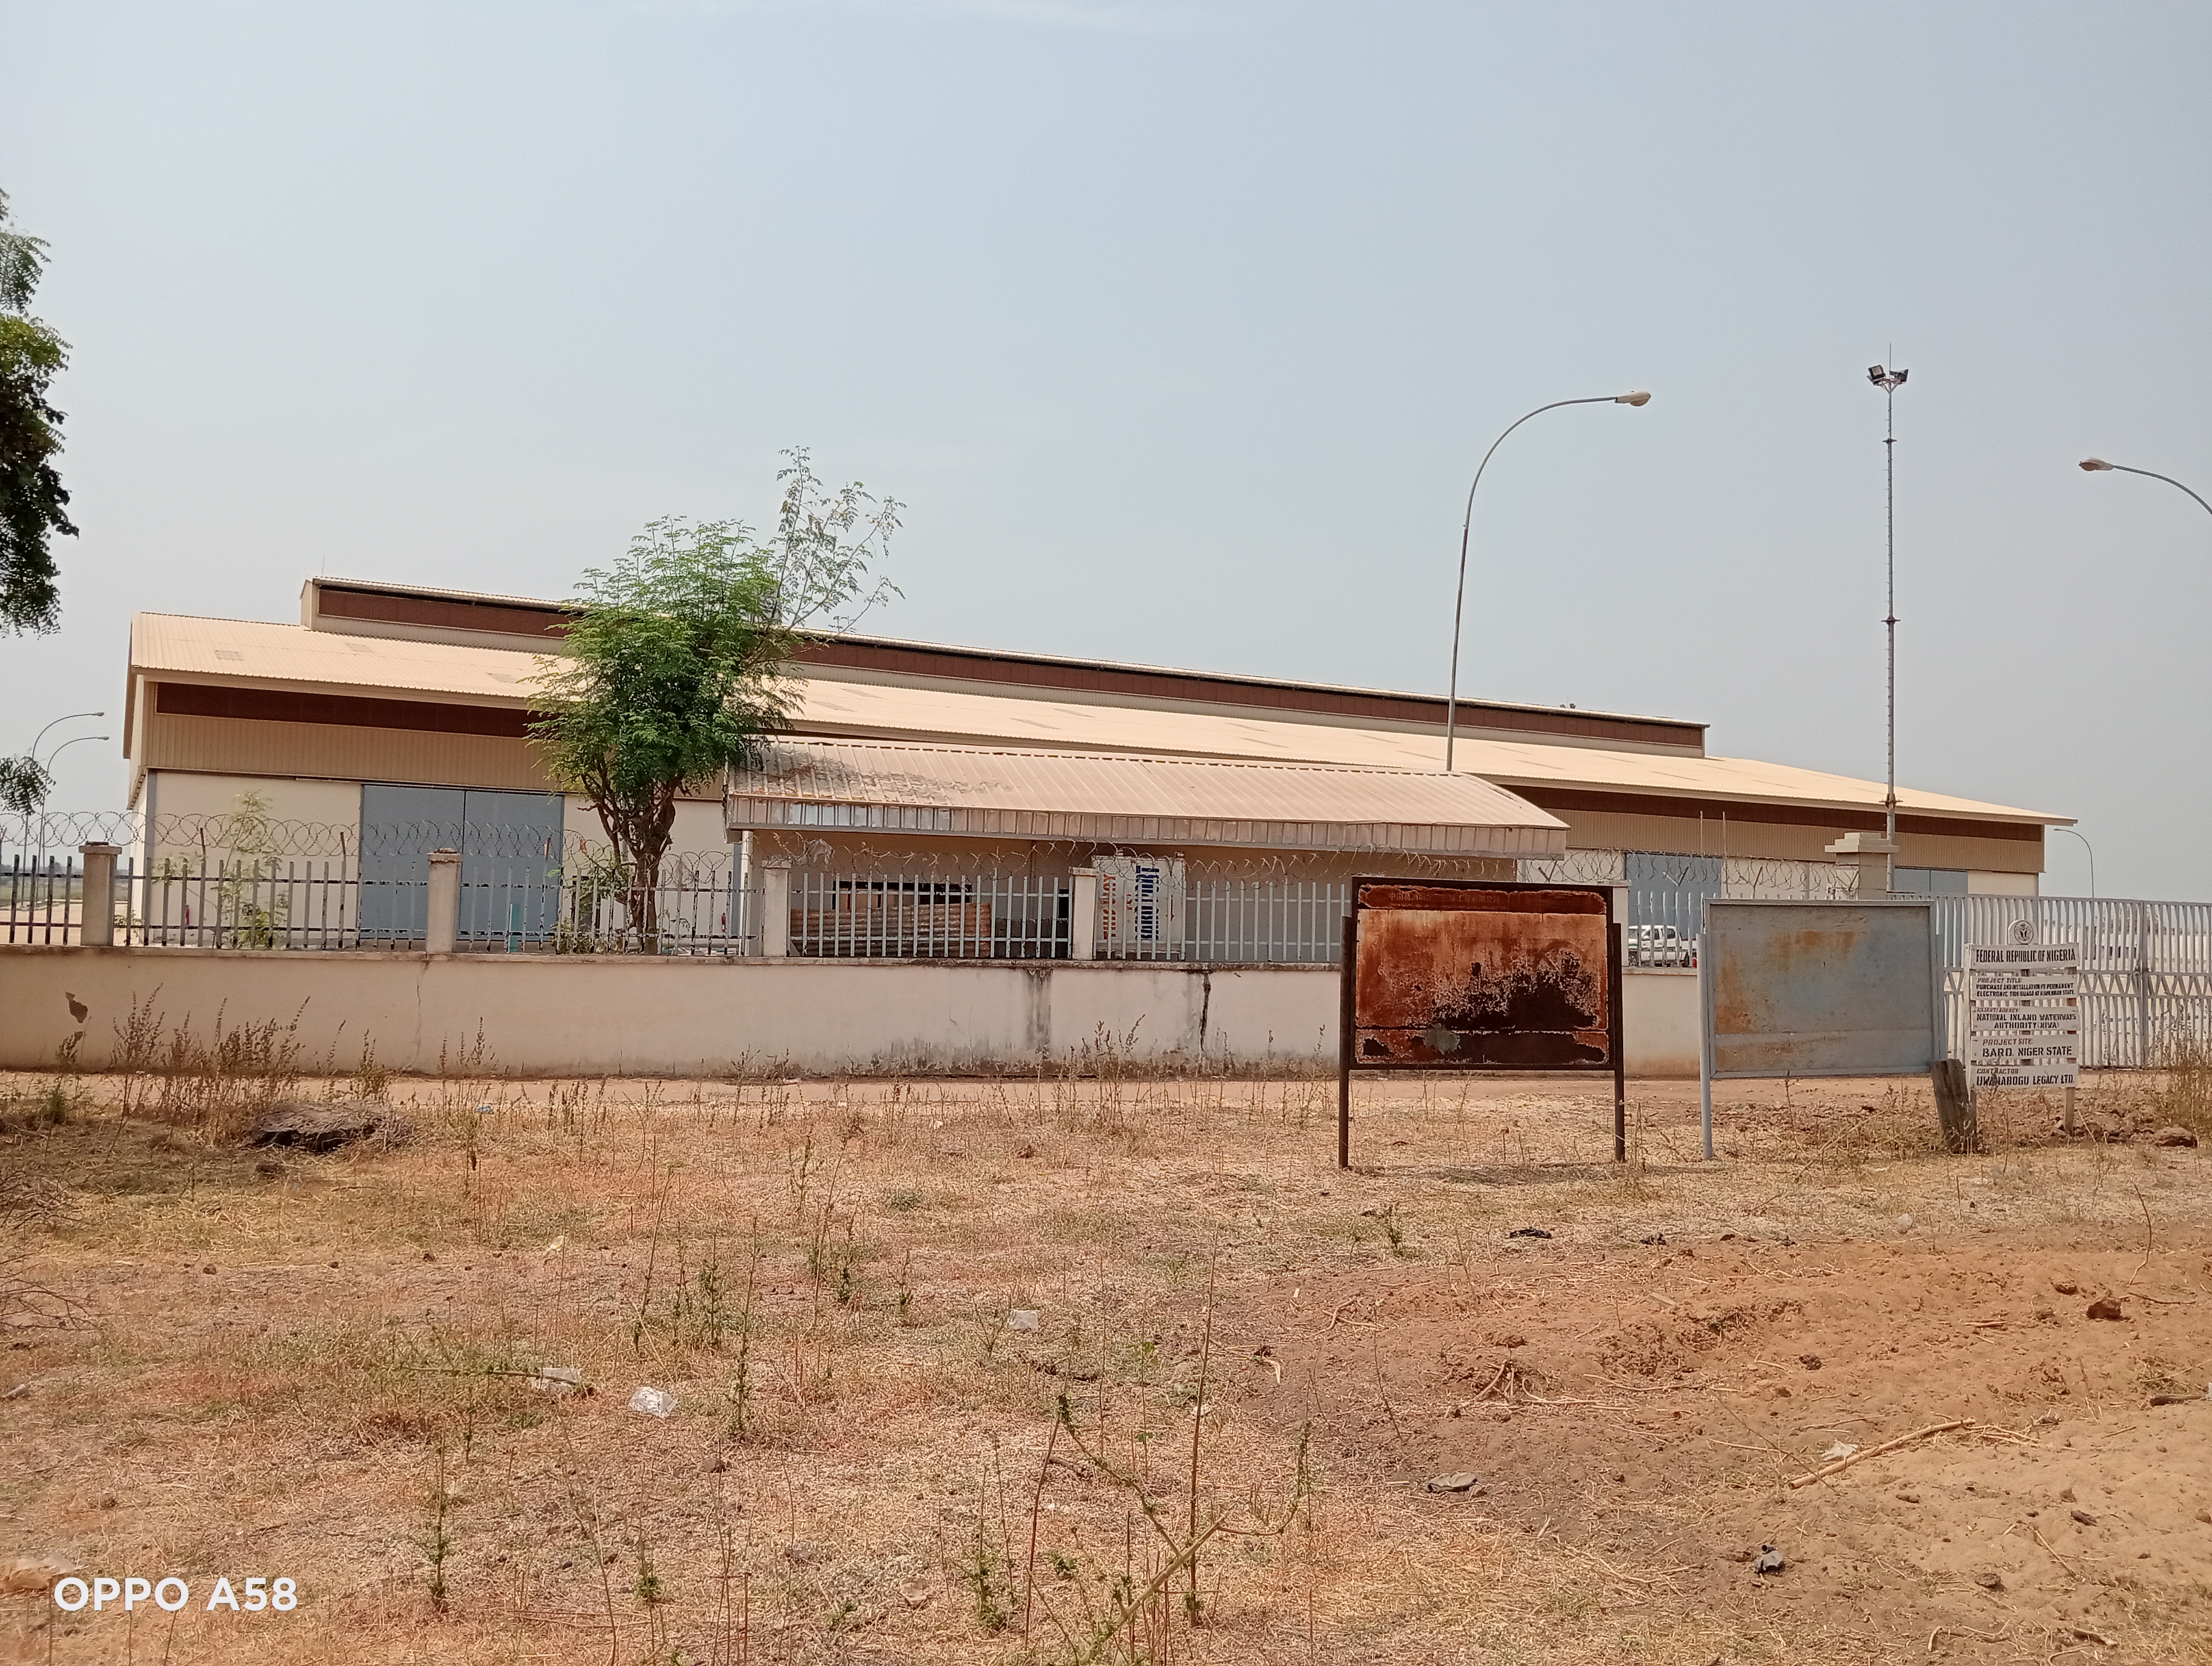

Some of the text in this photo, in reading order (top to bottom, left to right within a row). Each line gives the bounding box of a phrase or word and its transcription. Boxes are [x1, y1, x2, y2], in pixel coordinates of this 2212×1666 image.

[1976, 948, 2076, 963] FEDERAL REPUBLIC OF NIGERIA
[1977, 1013, 2007, 1021] NATIONAL
[2017, 1047, 2044, 1056] NIGER
[2046, 1046, 2072, 1055] STATE
[2033, 1074, 2059, 1085] LEGACY
[2060, 1074, 2074, 1084] LTD.
